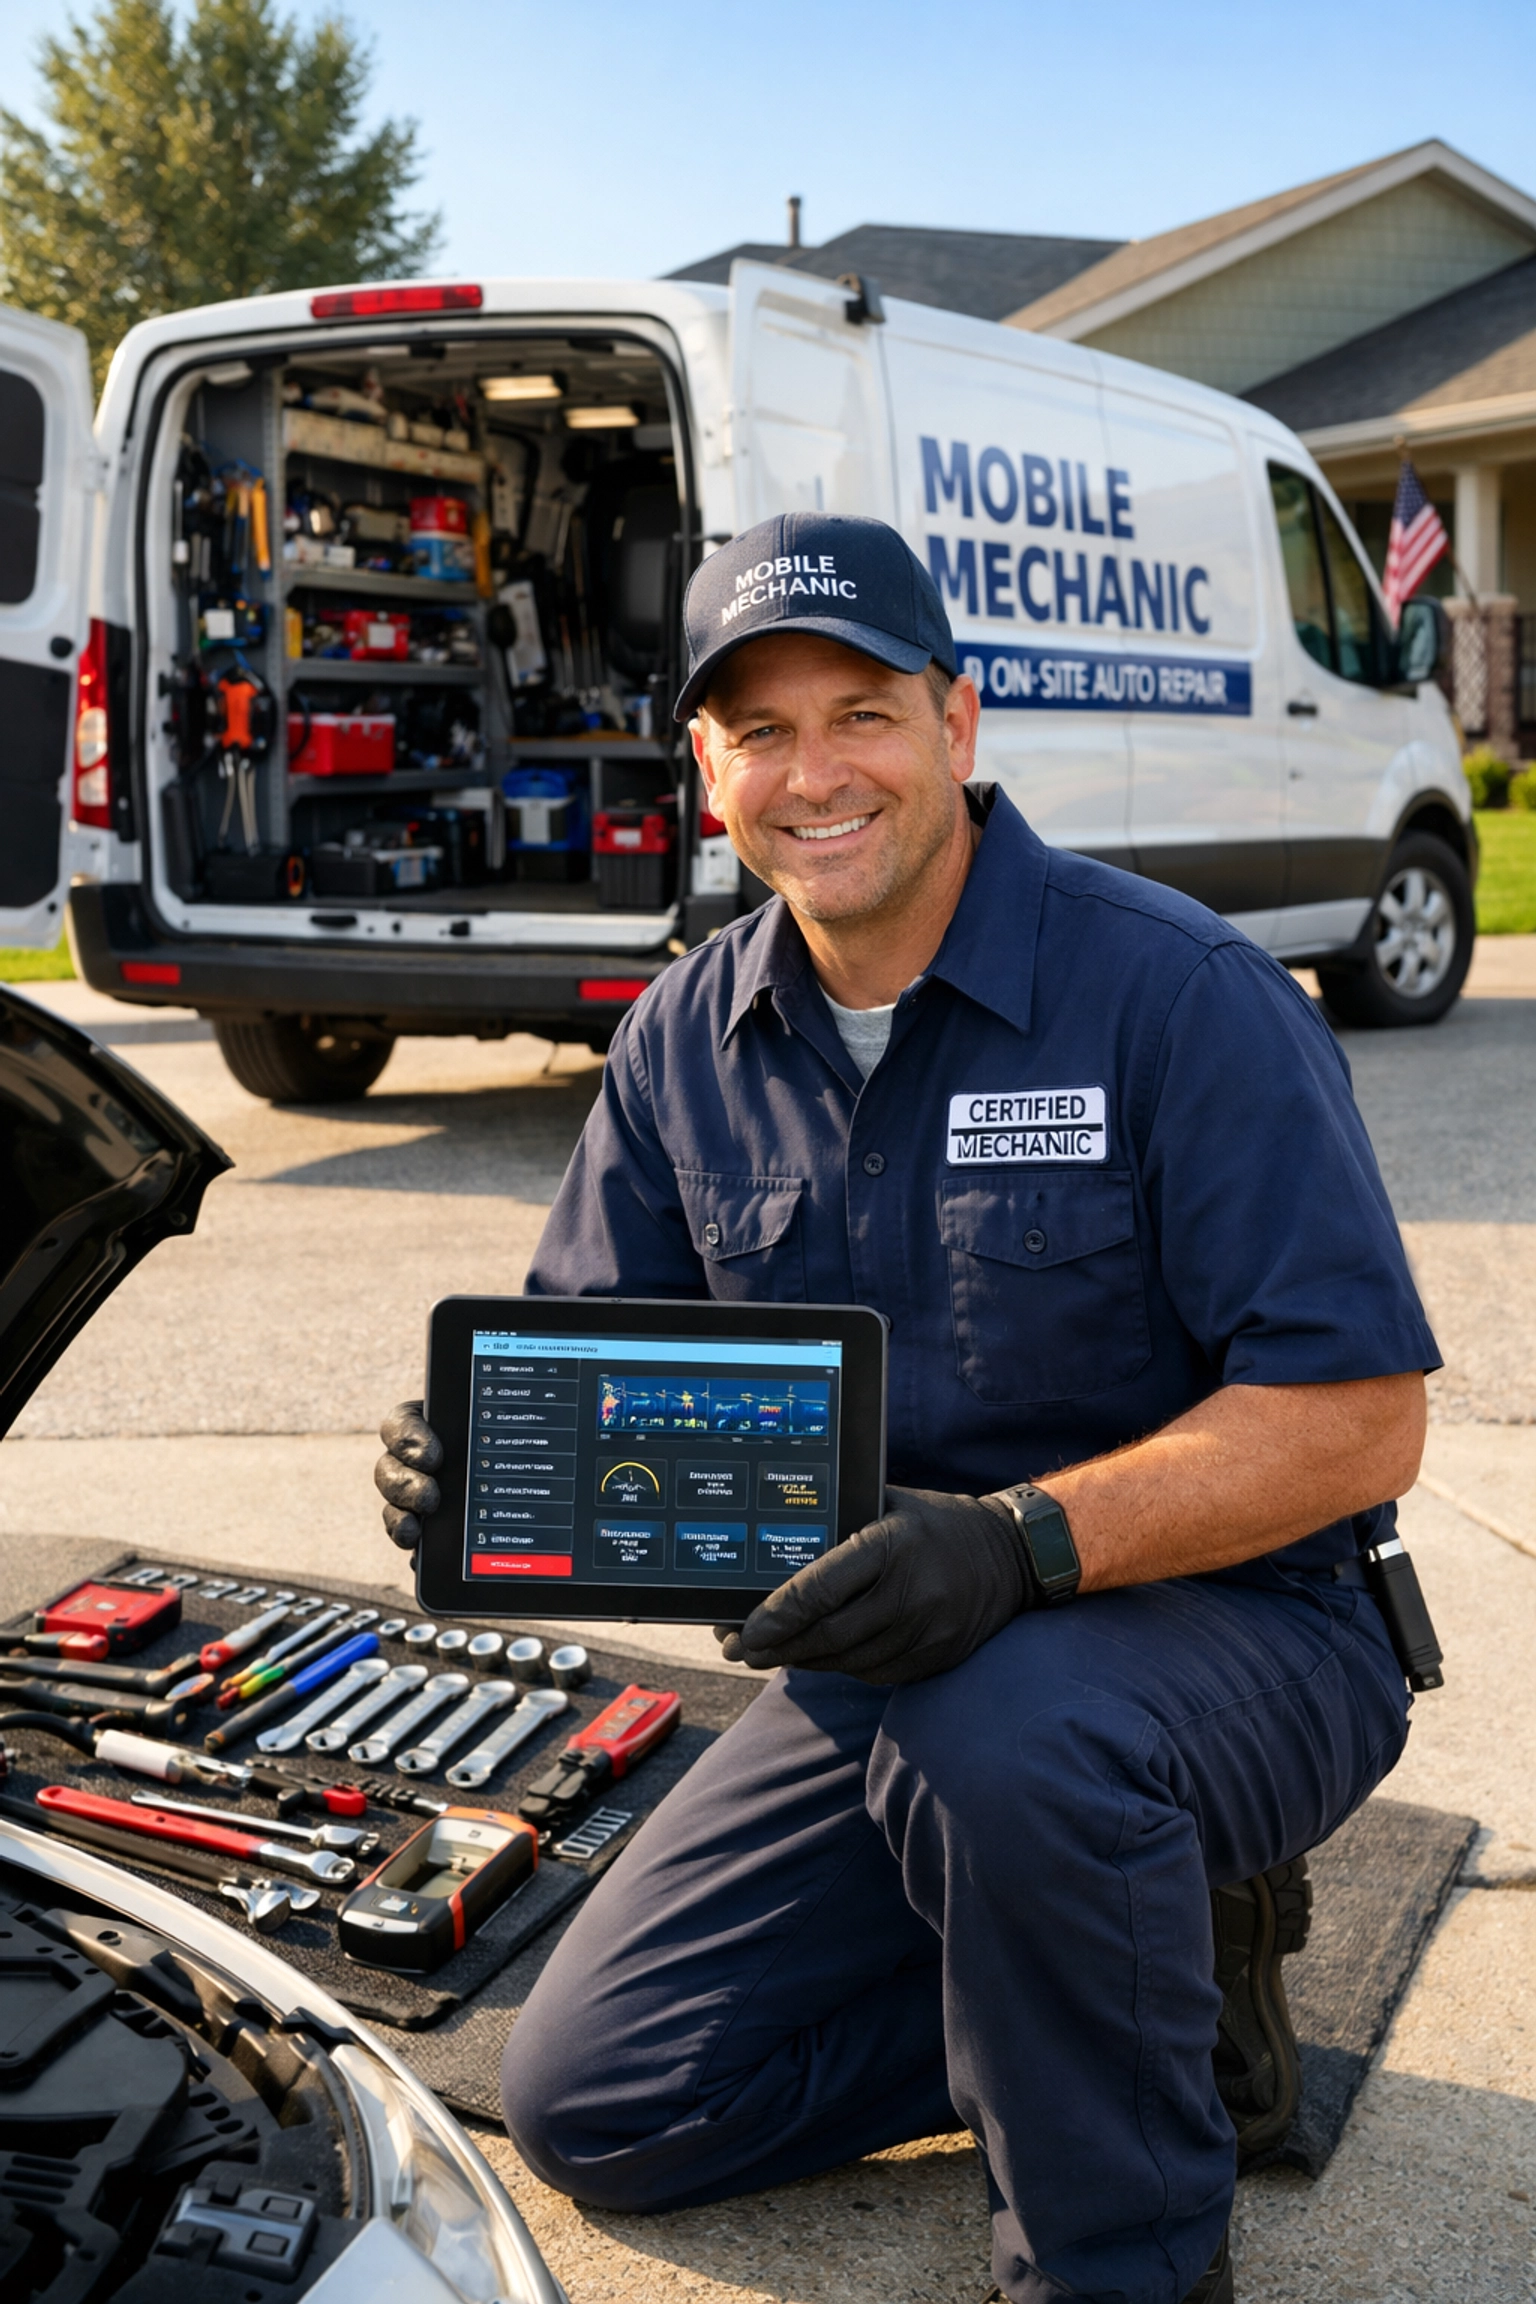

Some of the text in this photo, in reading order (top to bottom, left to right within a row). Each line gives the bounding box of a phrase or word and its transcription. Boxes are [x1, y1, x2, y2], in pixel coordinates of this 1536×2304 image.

[920, 435, 1134, 539] MOBILE
[735, 555, 837, 593] MOBILE
[927, 534, 1211, 635] MECHANIC
[721, 576, 857, 626] MECHANIC
[989, 656, 1088, 700] ON-SITE
[1091, 663, 1156, 702] AUTO
[1158, 666, 1228, 705] REPAIR
[968, 1095, 1086, 1123] CERTIFIED
[957, 1131, 1092, 1159] MECHANIC
